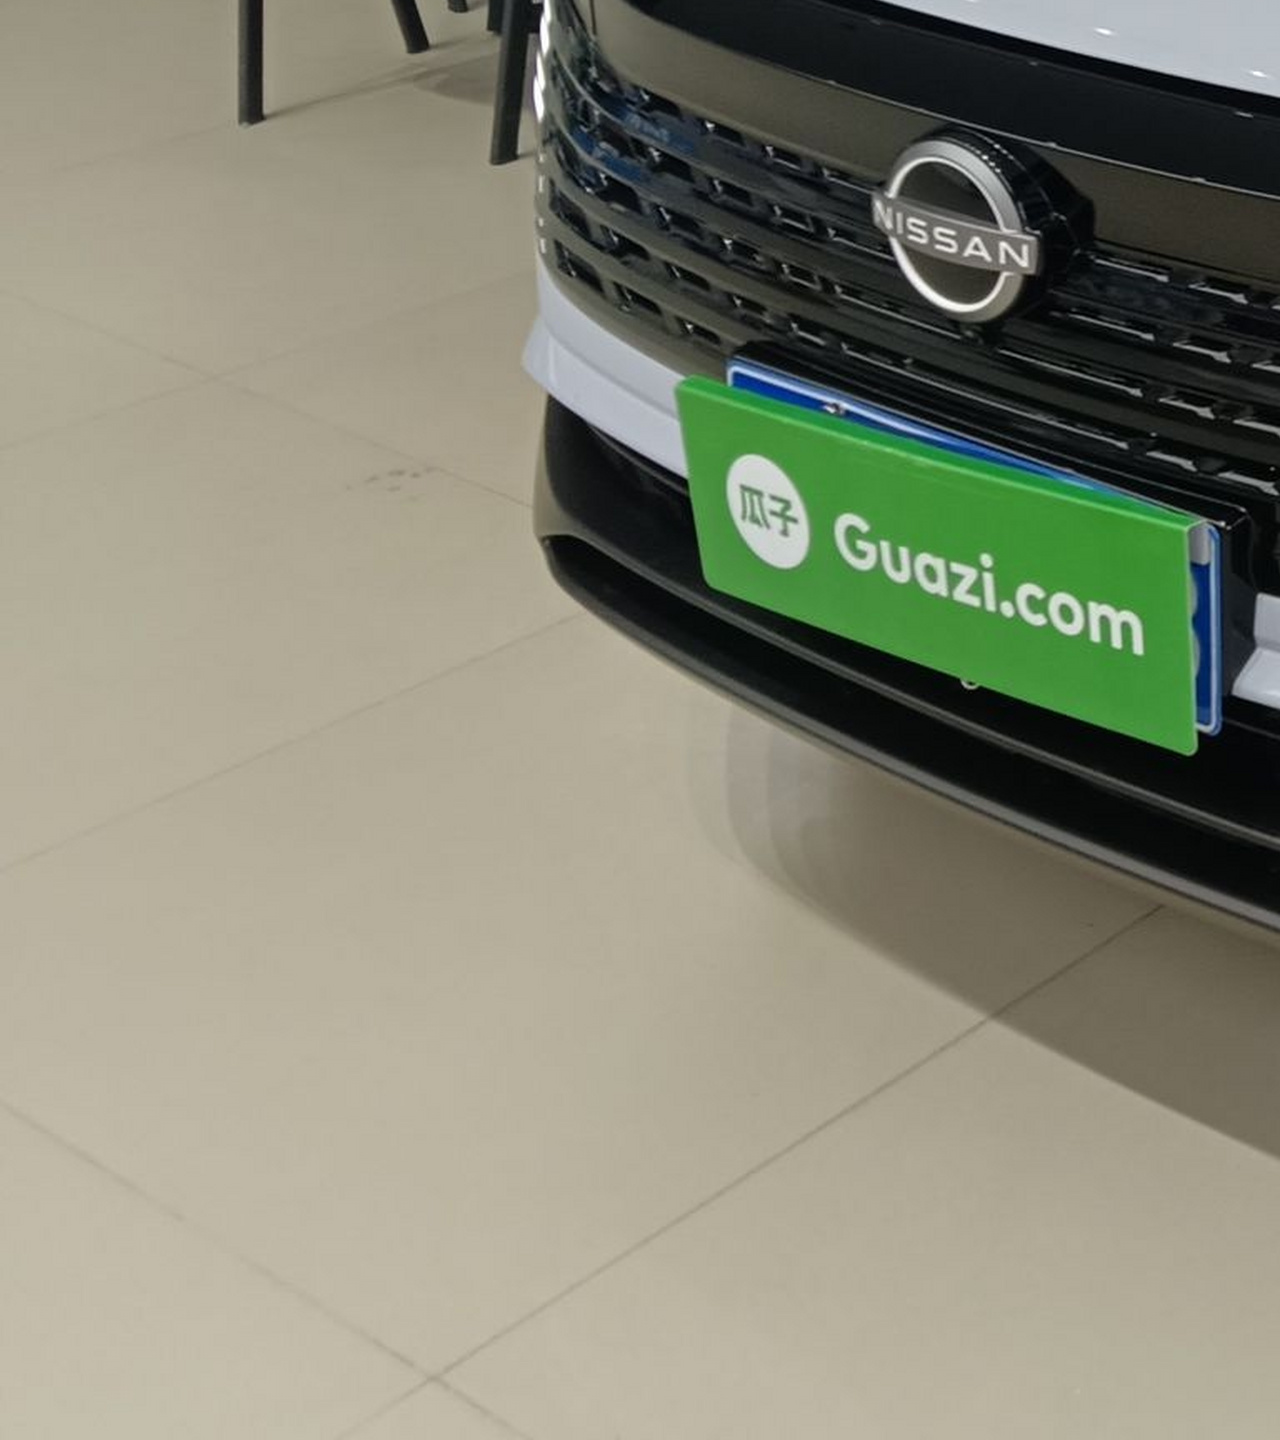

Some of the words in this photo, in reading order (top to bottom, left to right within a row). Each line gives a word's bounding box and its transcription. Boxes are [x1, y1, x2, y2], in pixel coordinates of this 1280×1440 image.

[874, 199, 1030, 269] NISSAN
[739, 484, 799, 538] 瓜子
[833, 512, 1145, 656] Guazi.com
